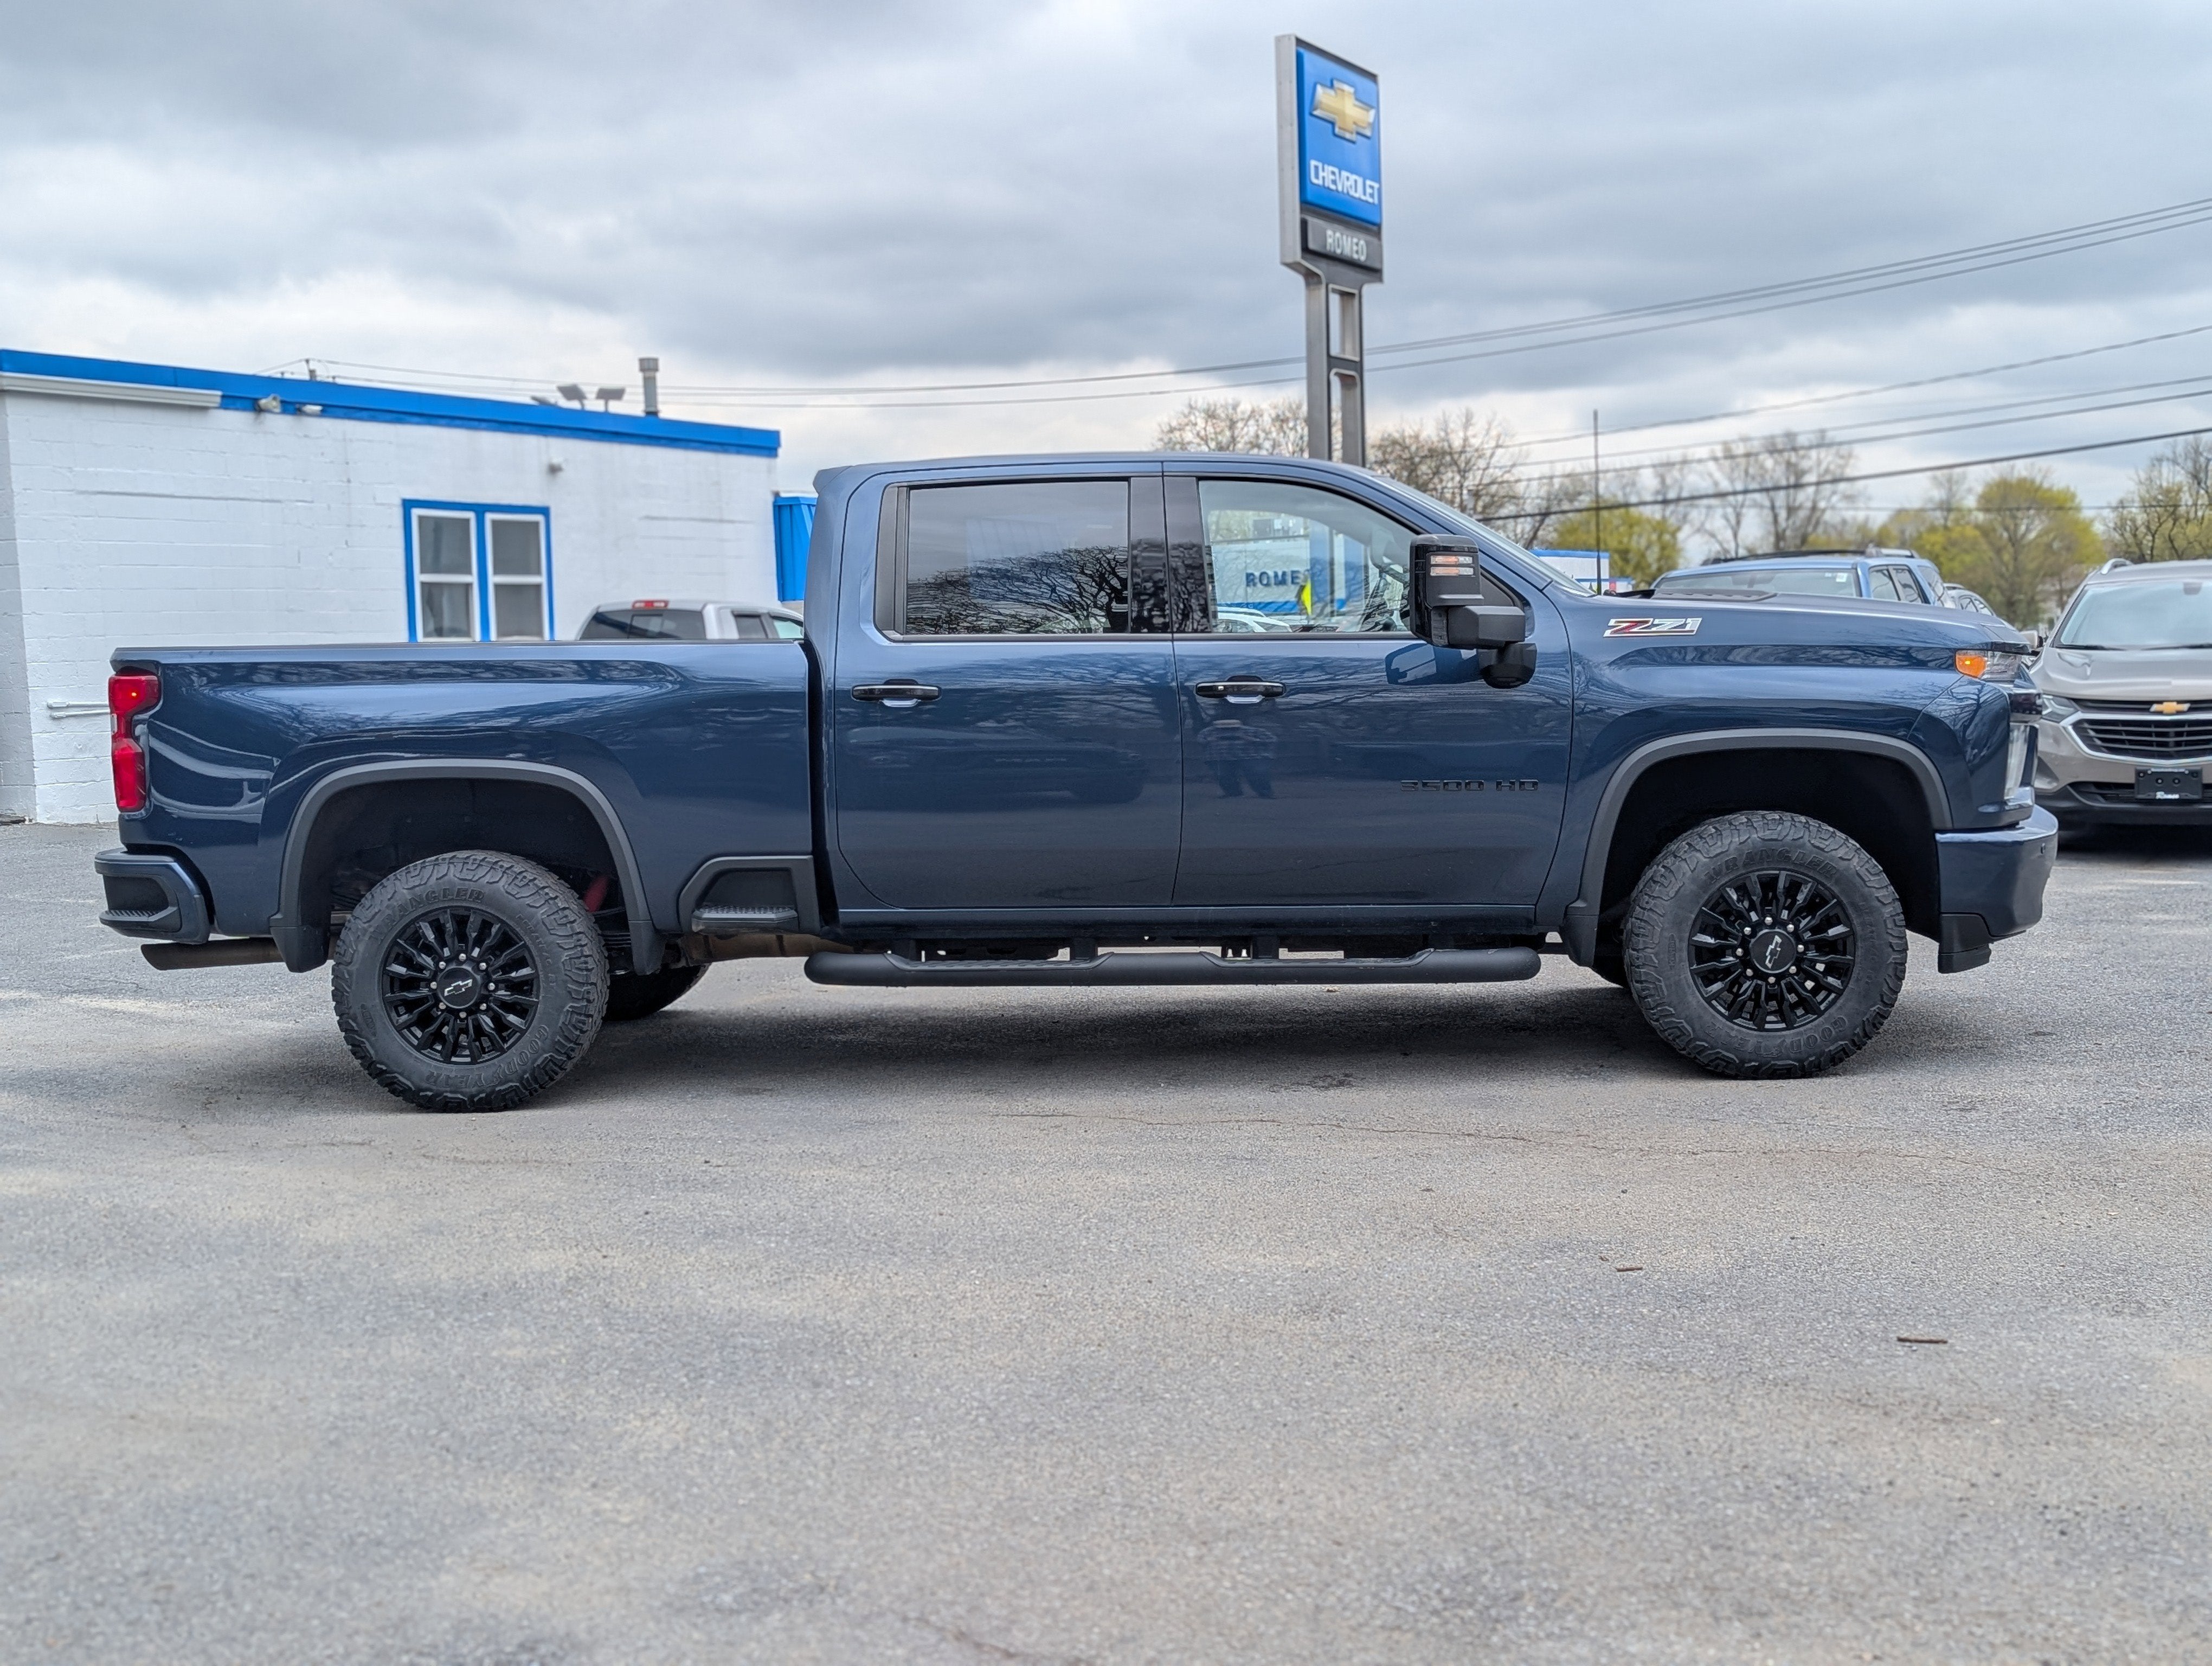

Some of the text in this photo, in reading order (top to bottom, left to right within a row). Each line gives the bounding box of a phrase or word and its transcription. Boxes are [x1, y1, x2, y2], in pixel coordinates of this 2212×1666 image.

[1310, 159, 1379, 204] CHEVROLET
[1326, 228, 1367, 262] ROMEO
[1603, 617, 1702, 638] Z71
[1495, 779, 1539, 791] HD
[1703, 848, 1838, 884] WRANGLER
[425, 1023, 550, 1089] GOODYEAR
